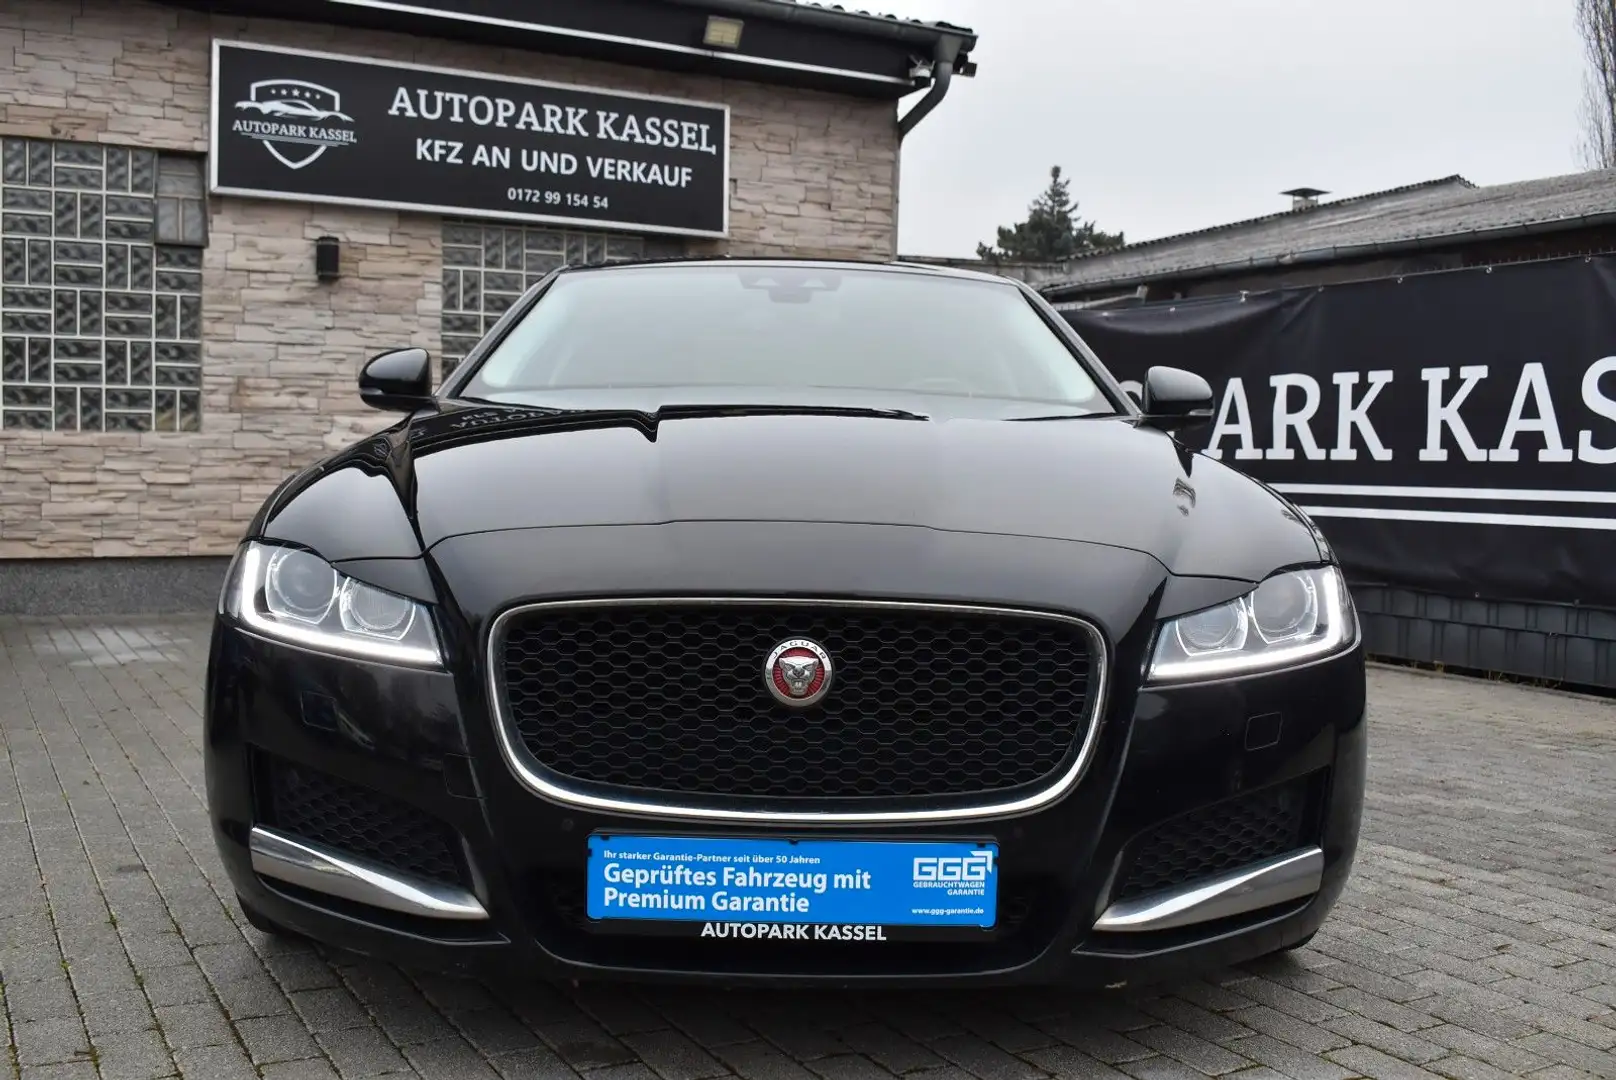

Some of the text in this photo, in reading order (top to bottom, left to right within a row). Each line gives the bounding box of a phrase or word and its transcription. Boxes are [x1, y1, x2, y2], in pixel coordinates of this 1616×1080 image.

[232, 119, 357, 143] AUTOPARK KASSEL
[388, 86, 717, 155] AUTOPARK KASSEL
[415, 138, 693, 188] KFZ AN UND VERKAUF
[507, 187, 609, 209] 0172 99 154 54
[1117, 370, 1394, 462] ARK
[773, 641, 827, 659] JAGUAR
[603, 850, 821, 865] Ihr starker Garantie-Partner seit über 50 Jahren
[913, 857, 986, 881] GGG
[603, 863, 871, 893] Geprüftes Fahrzeug mit
[603, 887, 810, 913] Premium Garantie
[911, 907, 984, 916] www.ggg-garantie.de
[701, 922, 887, 941] AUTOPARK KASSEL
